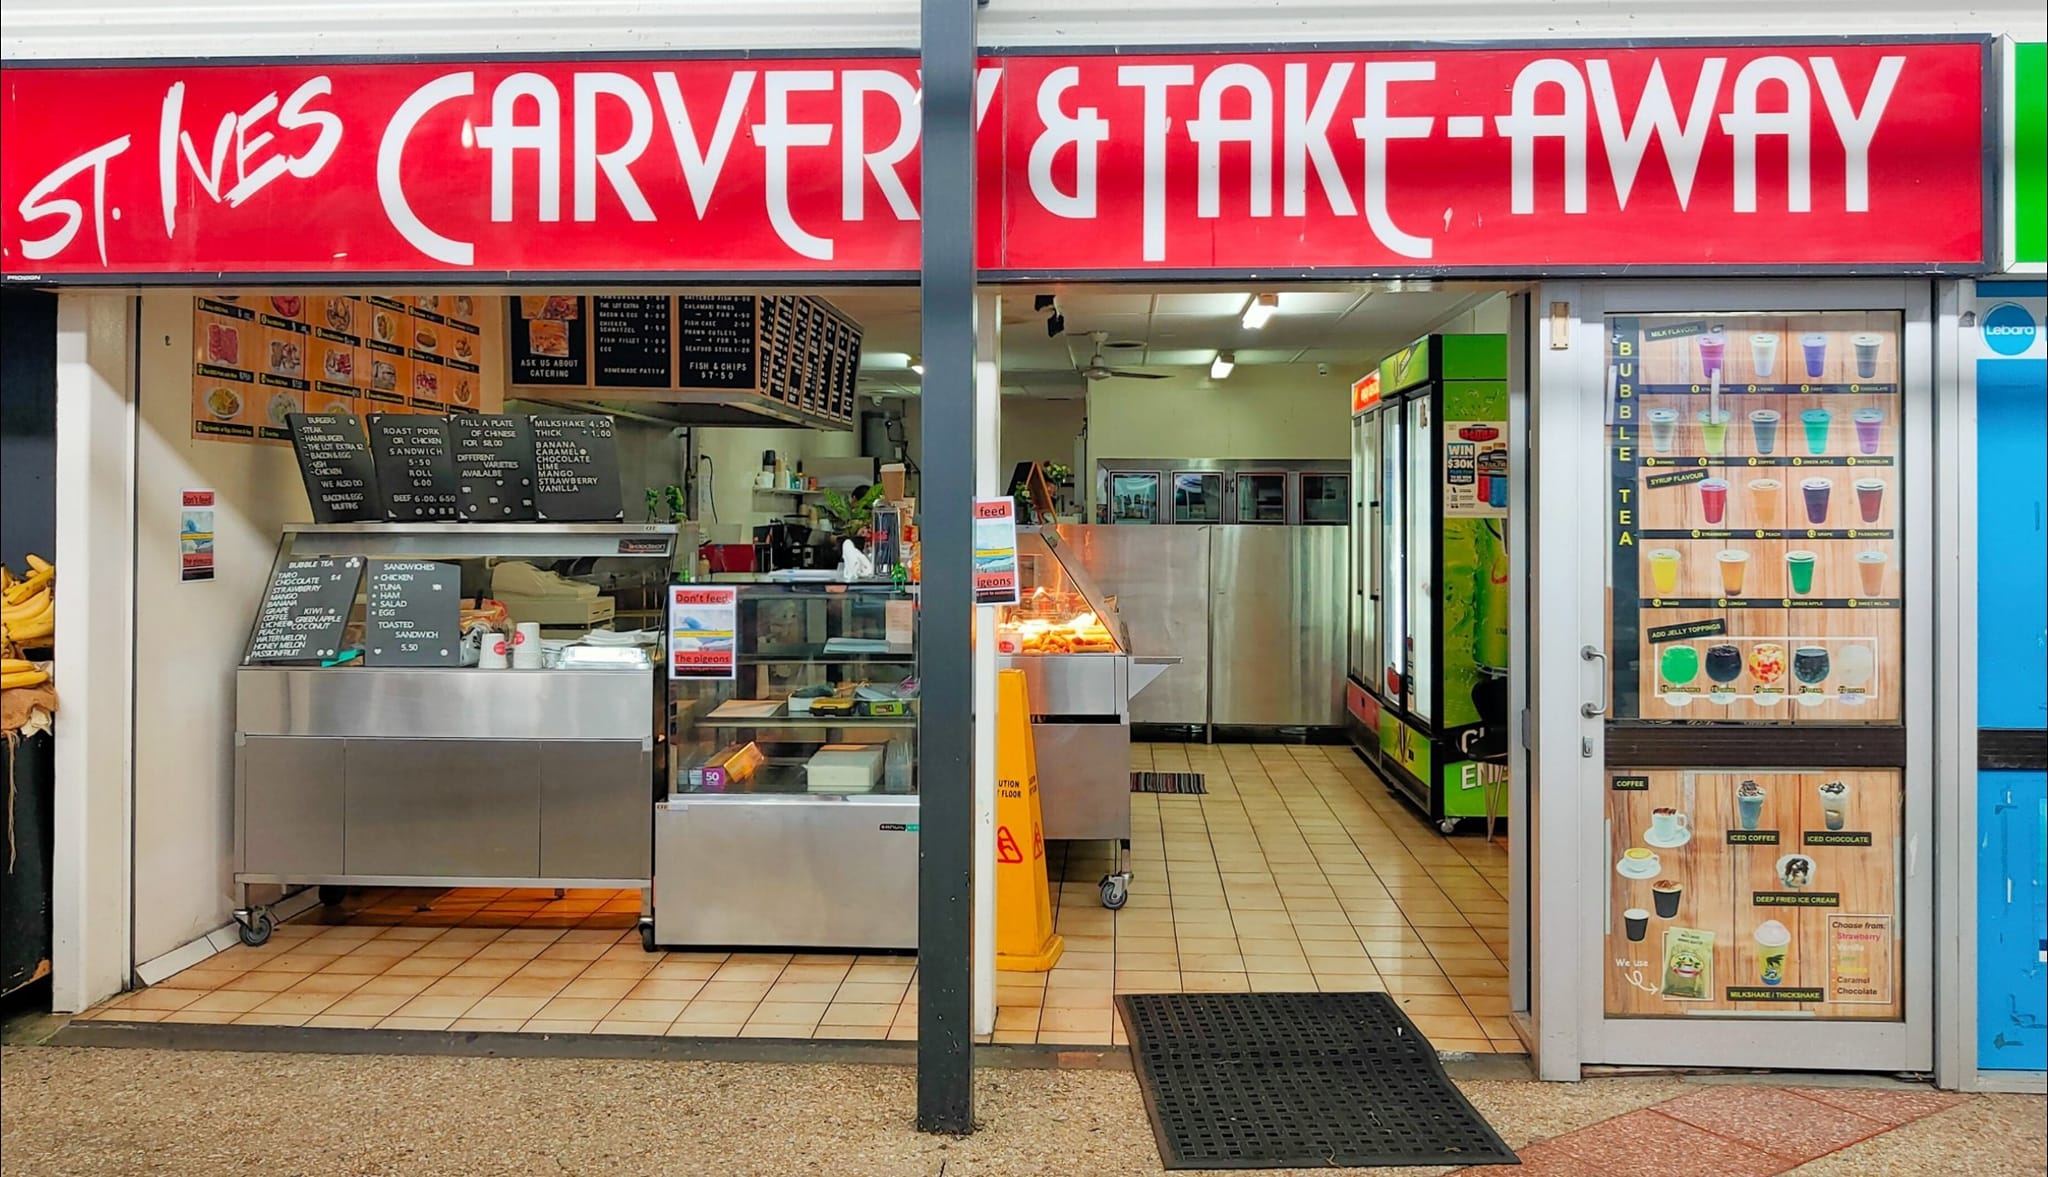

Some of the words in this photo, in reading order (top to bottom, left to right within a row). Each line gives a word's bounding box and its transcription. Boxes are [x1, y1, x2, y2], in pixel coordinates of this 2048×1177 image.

[18, 134, 132, 267] ST.
[160, 75, 345, 239] IVES
[377, 67, 1001, 266] CARVER
[1027, 65, 1109, 219] &
[1117, 55, 1904, 261] TAKE-AWAY
[1986, 324, 2035, 336] Lebara
[520, 359, 537, 367] ASK
[540, 359, 551, 367] US
[553, 359, 579, 368] ABOUT
[689, 361, 709, 370] FISH
[713, 361, 719, 370] &
[721, 362, 747, 371] CHIPS
[530, 369, 569, 378] CATERING
[1619, 342, 1633, 462] BUBBLE
[307, 416, 337, 424] BURGERS
[461, 419, 479, 427] FILL
[482, 419, 489, 427] A
[535, 420, 585, 428] MILKSHAKE
[383, 427, 412, 435] ROAST
[417, 428, 440, 436] PORK
[484, 430, 517, 438] CHINESE
[535, 429, 562, 437] THICK
[305, 435, 345, 443] HAMBURGER
[392, 437, 405, 445] OR
[411, 437, 442, 445] CHICKEN
[307, 443, 321, 451] THE
[536, 441, 576, 449] BANANA
[389, 448, 443, 456] SANDWICH
[536, 448, 580, 456] CARAMEL
[1448, 445, 1473, 455] WIN
[457, 454, 496, 462] DIFFERENT
[536, 455, 591, 463] CHOCOLATE
[484, 461, 519, 469] VARIETIES
[537, 463, 559, 471] LIME
[1447, 459, 1474, 469] $30K
[409, 469, 433, 477] ROLL
[538, 470, 574, 478] MANGO
[1673, 472, 1705, 482] FLAVOUR
[321, 480, 334, 488] WE
[336, 480, 352, 488] ALSO
[538, 477, 599, 485] STRAWBERRY
[538, 485, 579, 493] VANILLA
[980, 505, 1005, 517] feed
[1618, 489, 1633, 546] TEA
[289, 561, 318, 569] BUBBLE
[320, 560, 334, 568] TEA
[384, 563, 436, 571] SANDWICHES
[275, 577, 320, 586] CHOCOLATE
[380, 574, 413, 582] CHICKEN
[976, 577, 1012, 588] igeons
[272, 585, 321, 594] STRAWBERRY
[379, 583, 402, 591] TUNA
[270, 593, 298, 601] MANGO
[380, 591, 401, 599] HAM
[676, 593, 703, 603] Don't
[706, 593, 729, 603] feed
[266, 600, 298, 608] BANANA
[380, 600, 407, 608] SALAD
[265, 607, 290, 615] GRAPE
[303, 607, 323, 615] KIWI
[378, 609, 396, 617] EGG
[262, 614, 288, 622] COFFEE
[261, 620, 287, 629] LYCHEE
[378, 621, 414, 629] TOASTED
[258, 628, 283, 636] PEACH
[395, 631, 439, 639] SANDWICH
[1667, 628, 1686, 636] JELLY
[253, 642, 278, 650] HONEY
[279, 641, 306, 649] MELON
[251, 649, 300, 658] PASSIONFRUIT
[675, 654, 692, 663] The
[694, 654, 729, 664] pigeons
[705, 771, 720, 781] 50
[998, 780, 1020, 788] UTION
[1001, 790, 1022, 798] FLOOR
[1798, 896, 1810, 904] ICE
[1810, 896, 1837, 904] CREAM
[1832, 921, 1863, 929] Choose
[1836, 932, 1881, 942] Strawberry
[1615, 957, 1630, 967] We
[1836, 976, 1870, 984] Caramel
[1776, 991, 1820, 999] THICKSHAKE
[1836, 987, 1878, 995] Chocolate
